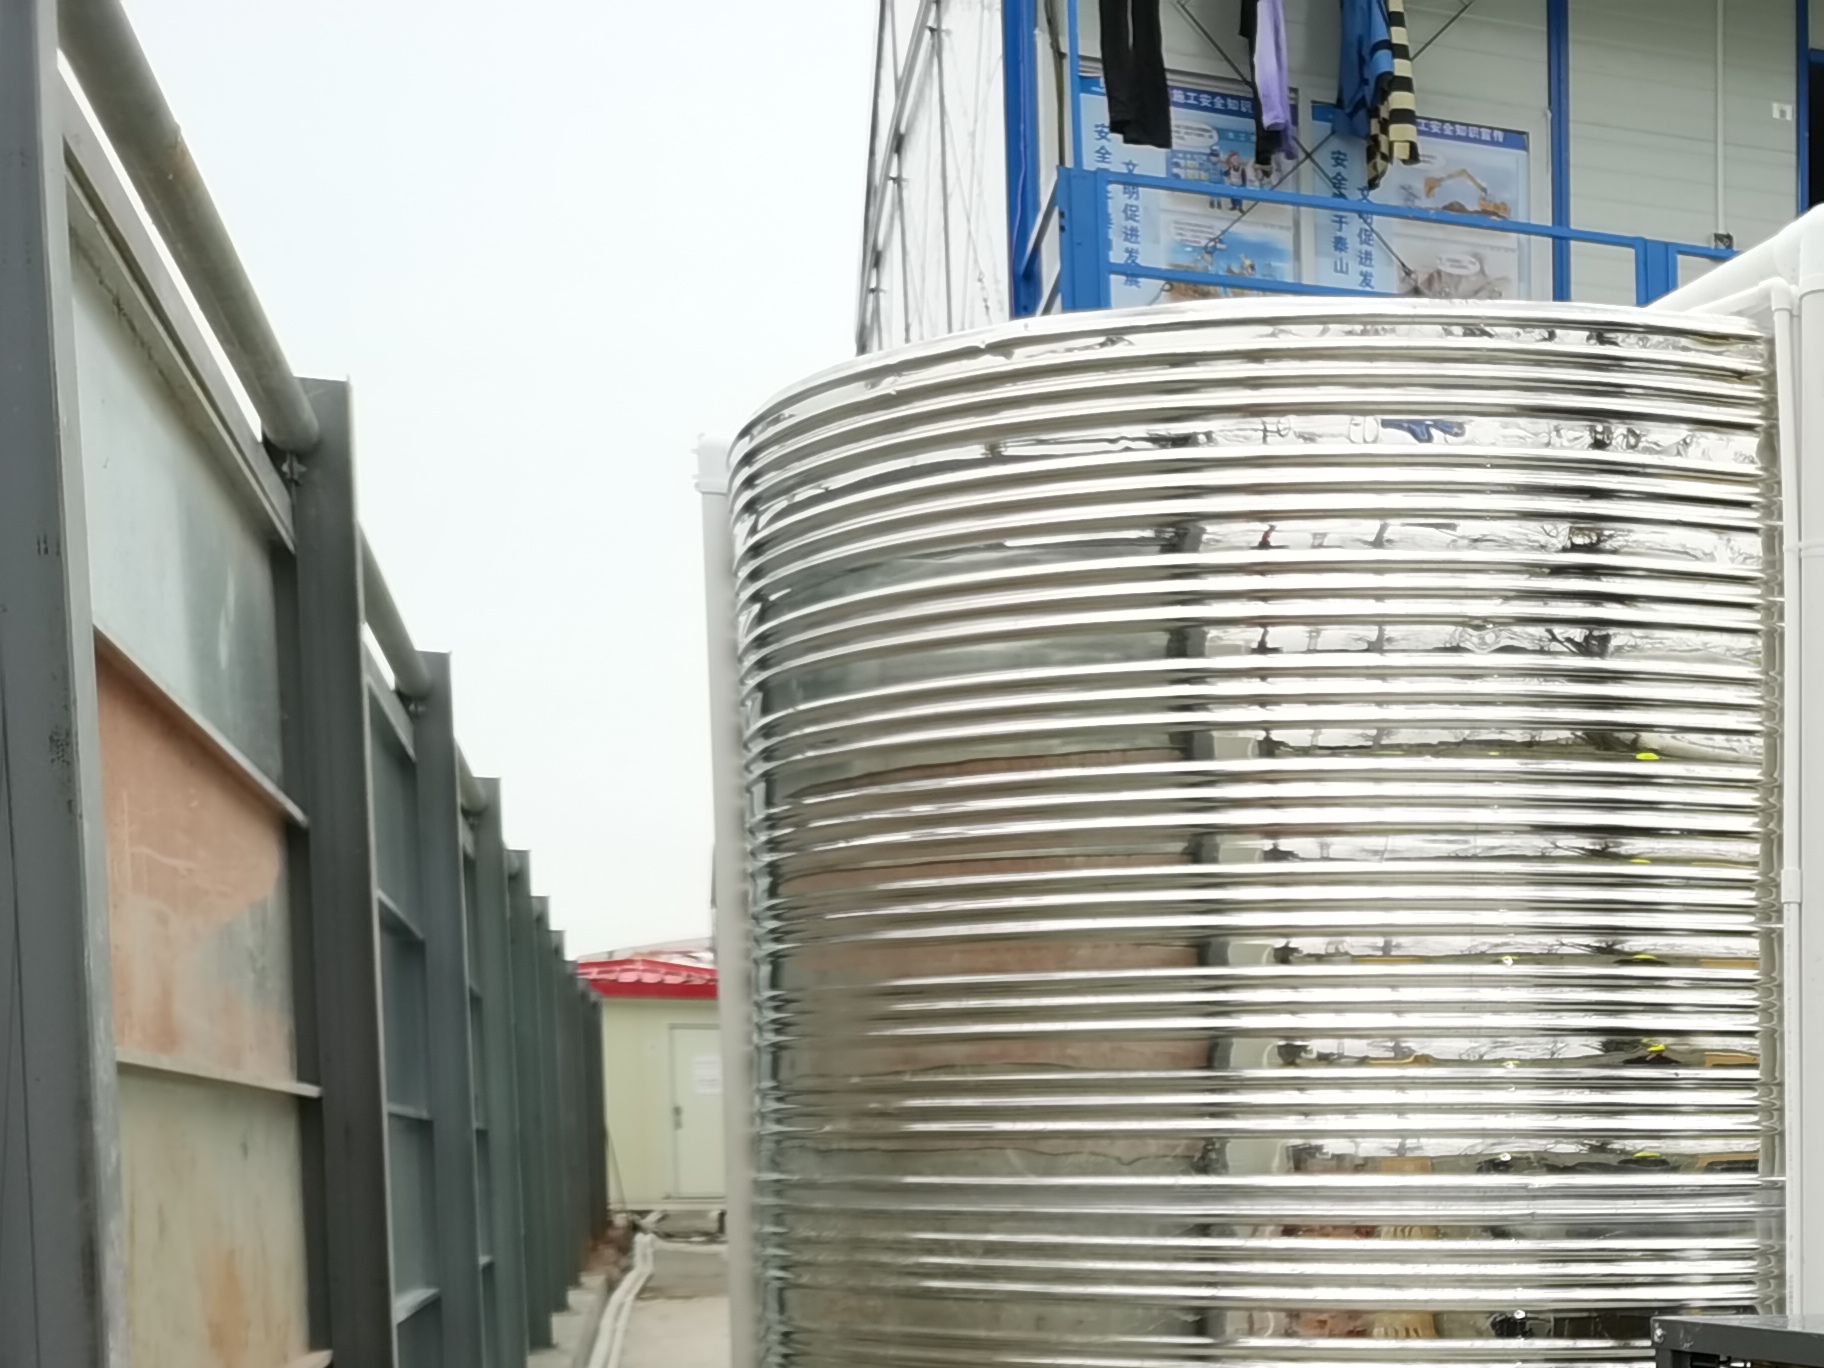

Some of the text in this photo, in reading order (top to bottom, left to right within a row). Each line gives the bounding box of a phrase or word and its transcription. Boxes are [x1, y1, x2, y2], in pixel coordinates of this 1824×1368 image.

[1171, 89, 1254, 114] 施工安全知识
[1418, 119, 1505, 143] 工安全知识宣传
[1331, 150, 1350, 276] 安全于泰山
